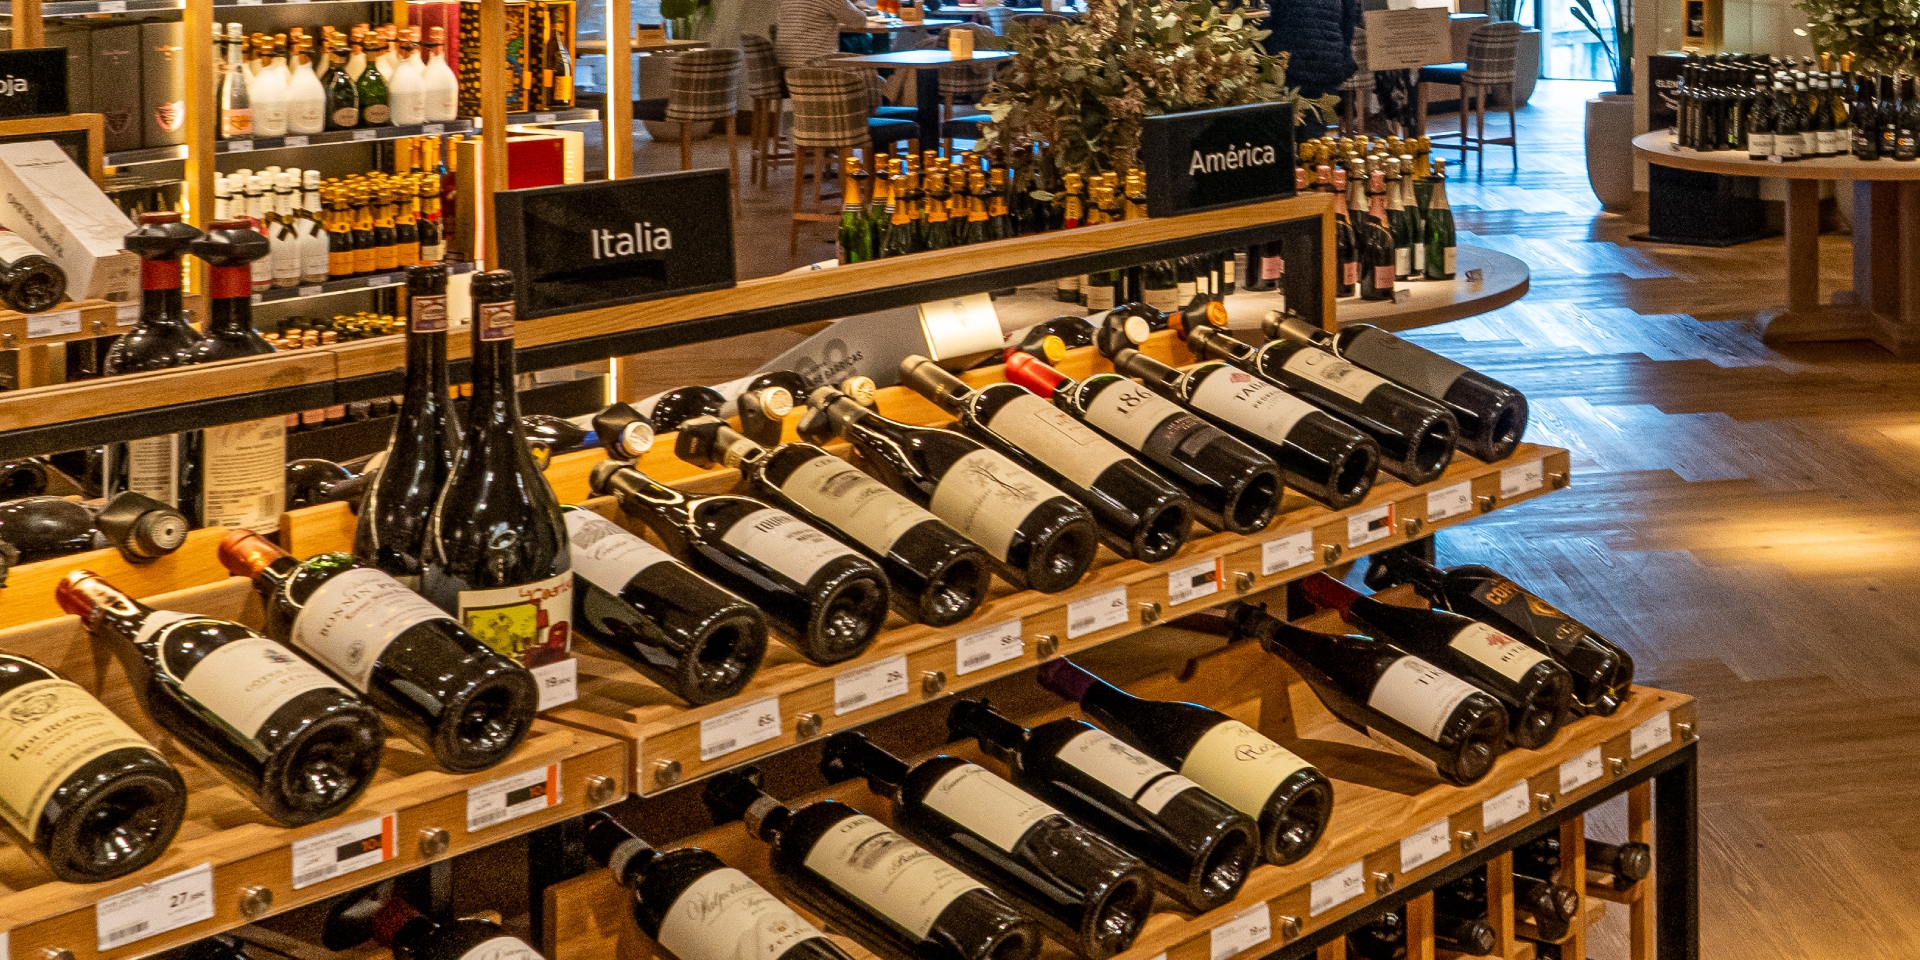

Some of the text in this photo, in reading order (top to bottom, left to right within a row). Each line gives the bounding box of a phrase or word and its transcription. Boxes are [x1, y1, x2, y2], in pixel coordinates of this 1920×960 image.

[0, 75, 29, 97] oja
[1188, 142, 1276, 176] América
[590, 221, 672, 260] Italia
